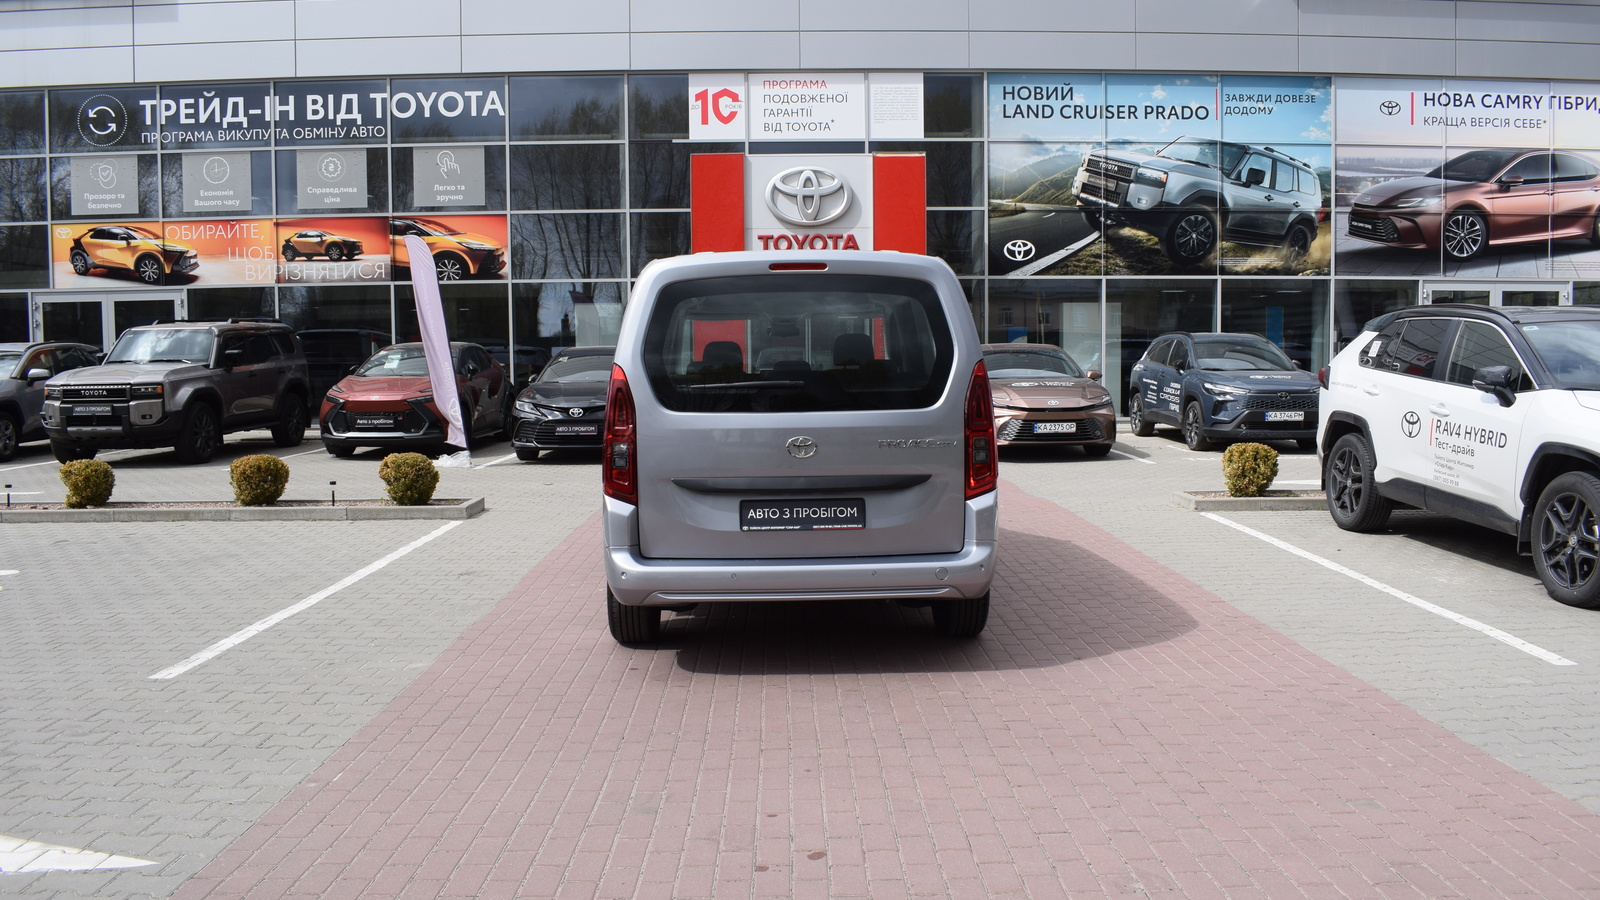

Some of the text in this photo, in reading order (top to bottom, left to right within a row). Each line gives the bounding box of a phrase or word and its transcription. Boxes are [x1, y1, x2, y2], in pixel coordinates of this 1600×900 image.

[763, 80, 827, 90] ПРОГРАМА
[1002, 82, 1074, 100] НОВИЙ
[764, 92, 848, 105] ПОДОВЖЕНОЇ
[1224, 94, 1316, 104] ЗАВЖДИ ДОВЕЗЕ
[1424, 92, 1600, 114] НОВА CAMRY ГІБРИ
[139, 90, 506, 128] ТРЕЙД-ІН ВІД TOYOTA
[764, 106, 813, 117] ГАРАНТІЇ
[1002, 104, 1209, 120] LAND CRUISER PRADO
[1224, 106, 1274, 116] ДОДОМУ
[764, 122, 782, 133] ВІД
[1424, 116, 1467, 128] КРАЩА
[1471, 117, 1510, 128] ВЕРСІЯ
[142, 126, 386, 144] ПРОГРАМА ВИКУПУ ТА ОБМІНУ АВТО
[307, 186, 358, 195] Справедлива
[434, 184, 455, 192] Легко
[84, 193, 115, 201] Прозоро
[324, 196, 340, 204] ціна
[165, 221, 264, 240] ОБИРАЙТЕ,
[757, 234, 860, 250] TOYOTA
[228, 246, 274, 263] ЩОБ
[245, 262, 385, 281] ВИРІЗНЯТИСЯ
[1160, 393, 1180, 403] CROSS
[1435, 419, 1508, 449] RAV4 HYBRID
[1435, 438, 1475, 457] Тест-драйв
[748, 507, 858, 519] АВТО З ПРОБІГОМ
